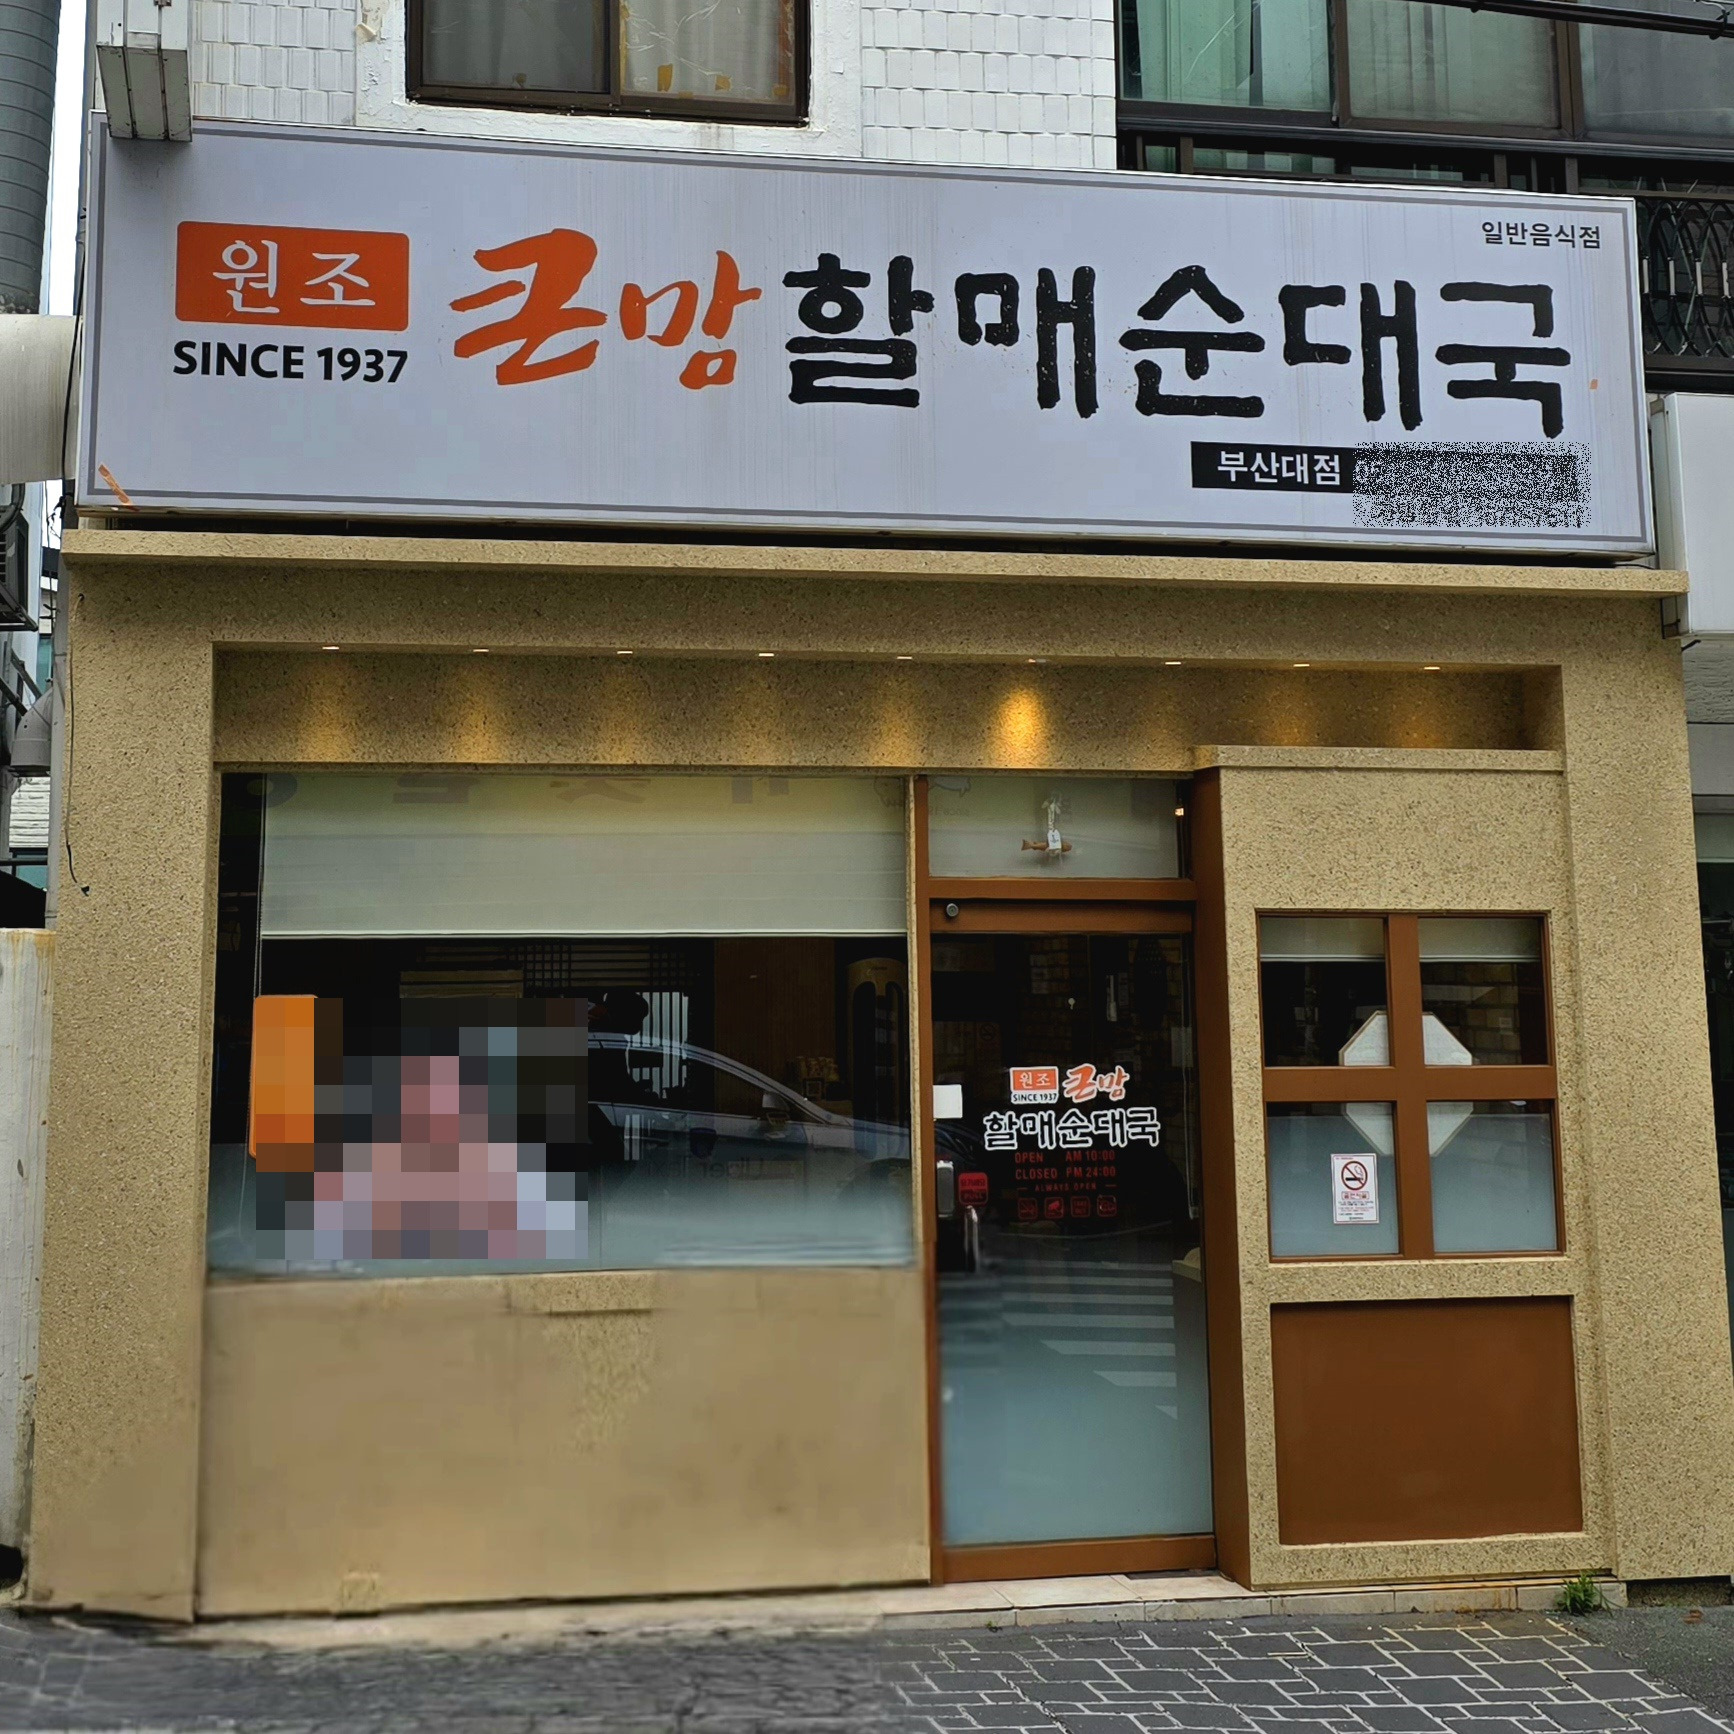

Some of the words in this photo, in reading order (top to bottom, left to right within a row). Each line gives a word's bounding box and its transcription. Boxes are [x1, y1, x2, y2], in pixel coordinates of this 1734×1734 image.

[1482, 221, 1600, 249] 일반음식점
[213, 240, 376, 313] 원조
[173, 340, 305, 379] SINCE
[316, 346, 408, 383] 1937
[782, 252, 1572, 439] 할매순대국
[1217, 450, 1341, 486] 부산대점
[1019, 1072, 1051, 1089] 원조
[1013, 1093, 1038, 1102] SINCE
[1039, 1092, 1058, 1101] 1937
[983, 1107, 1161, 1150] 할매순대국
[1014, 1152, 1044, 1164] OPEN
[1065, 1150, 1083, 1162] AM
[1085, 1149, 1116, 1161] 10:00
[1015, 1168, 1058, 1180] CLOSED
[1066, 1166, 1083, 1178] PM
[1085, 1166, 1116, 1178] 24:00
